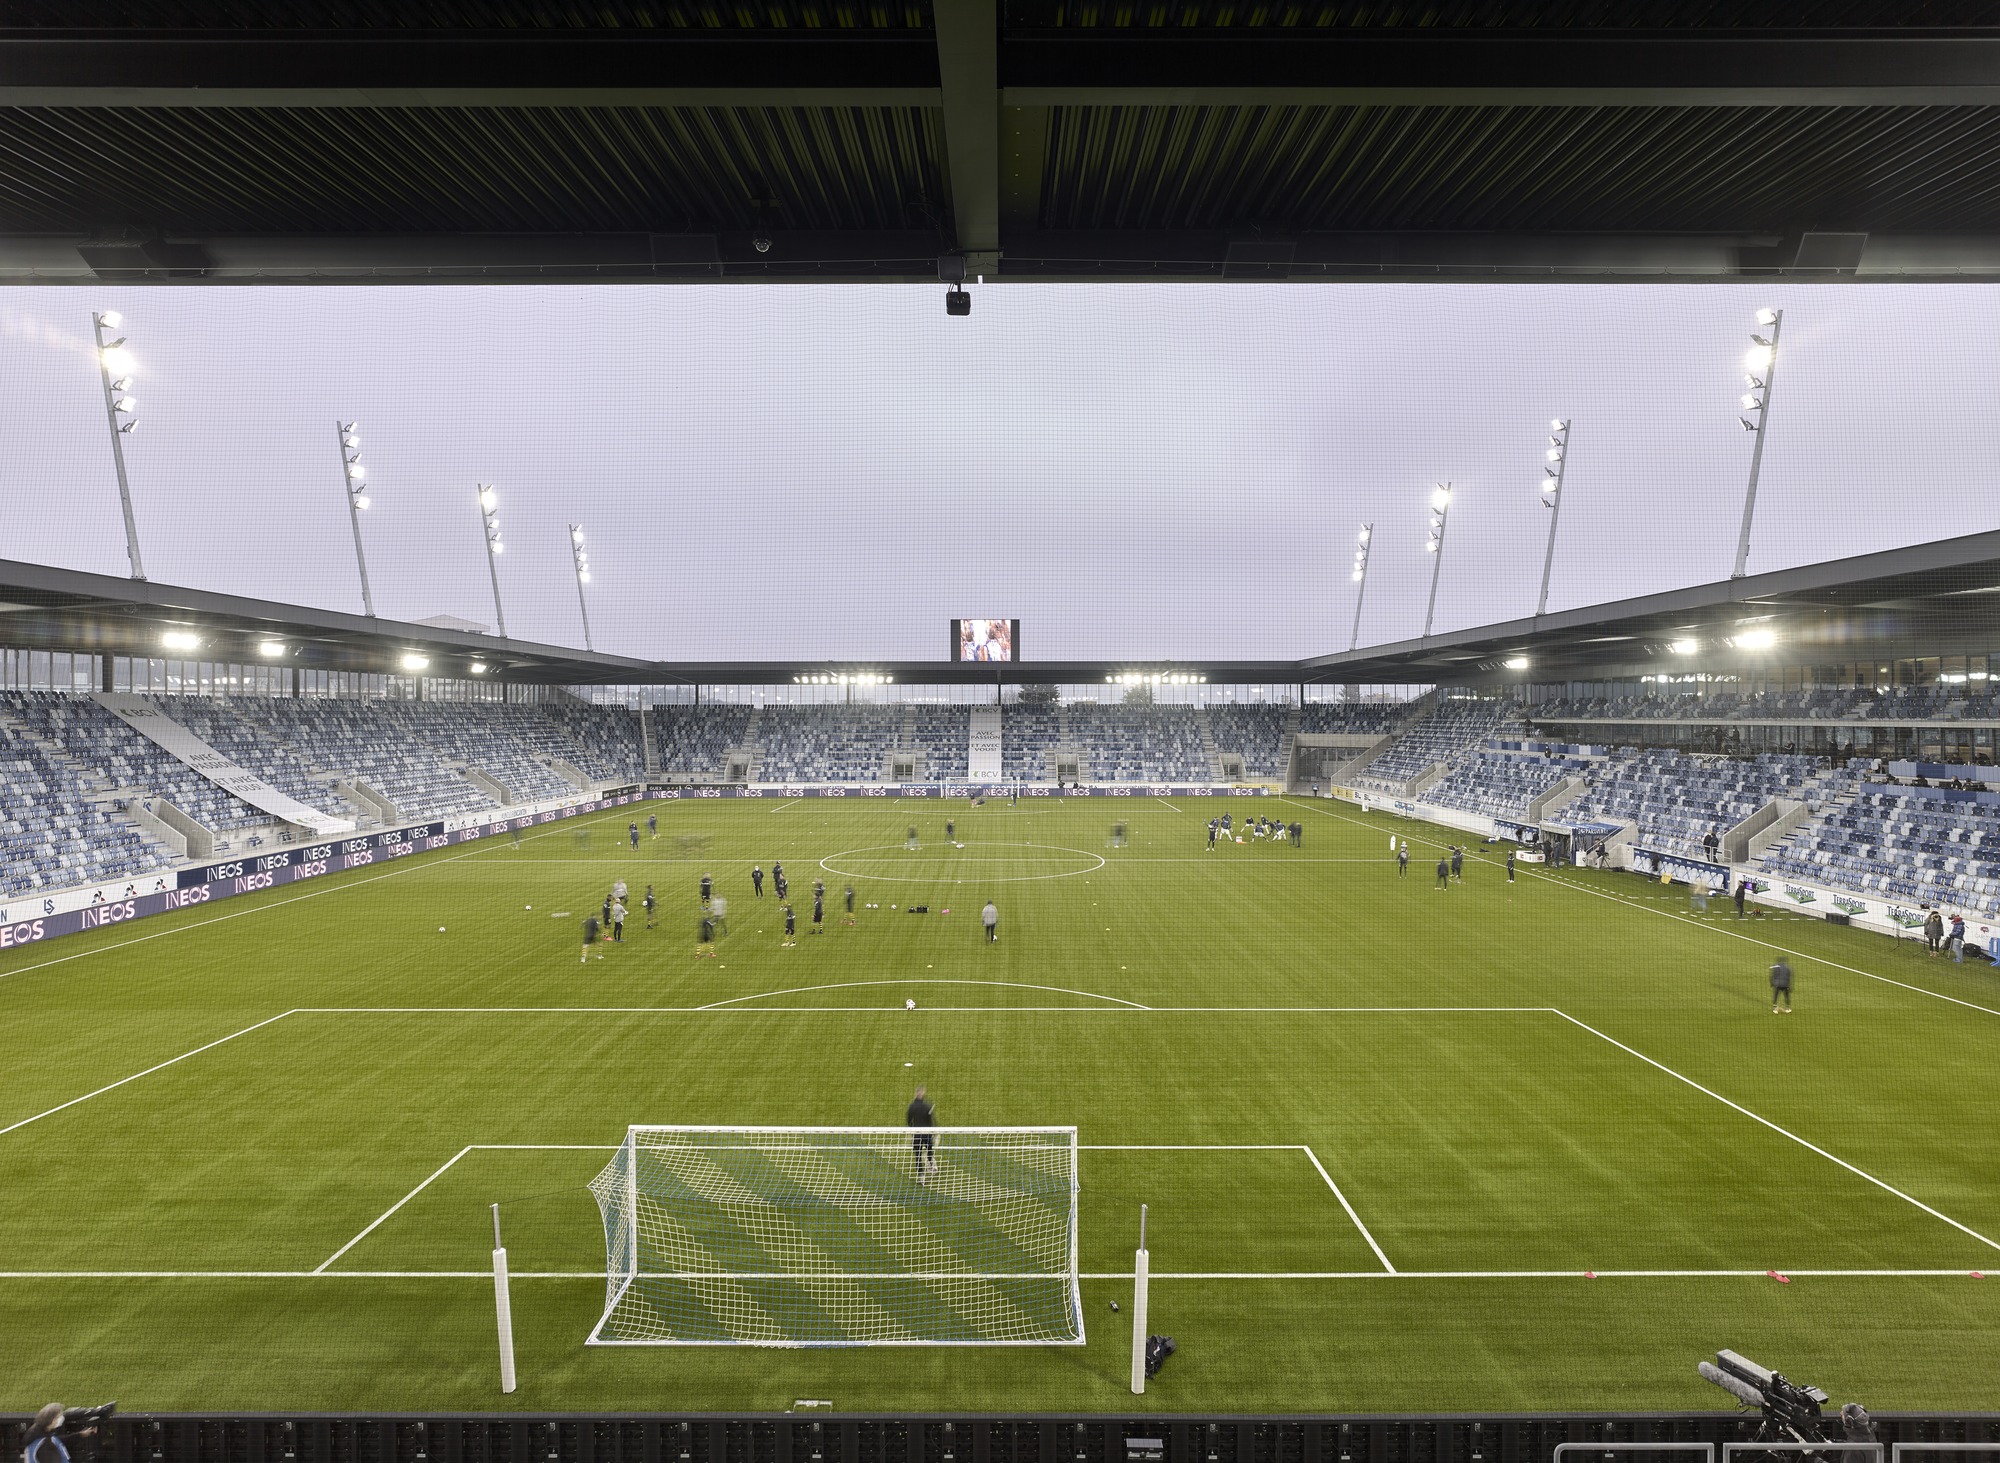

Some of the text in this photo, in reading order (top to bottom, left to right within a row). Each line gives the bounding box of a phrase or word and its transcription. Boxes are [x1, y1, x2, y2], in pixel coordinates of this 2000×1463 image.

[190, 760, 237, 770] PASSION
[230, 776, 258, 784] AVEC
[652, 790, 679, 799] INEOS
[694, 789, 721, 798] INEOS
[736, 789, 762, 797] INEOS
[778, 789, 804, 797] INEOS
[820, 788, 846, 796] INEOS
[860, 788, 886, 796] INEOS
[902, 788, 927, 796] INEOS
[540, 811, 556, 823] INEOS
[562, 806, 576, 818] INEOS
[490, 822, 508, 835] INEOS
[516, 816, 533, 829] INEOS
[378, 832, 402, 846] INEOS
[408, 826, 428, 840] INEOS
[460, 828, 480, 842] INEOS
[342, 838, 368, 854] INEOS
[426, 834, 449, 850] INEOS
[303, 844, 332, 862] INEOS
[388, 842, 413, 858] INEOS
[256, 853, 289, 872] INEOS
[344, 850, 372, 868] INEOS
[206, 862, 243, 882] INEOS
[294, 860, 326, 880] INEOS
[234, 871, 273, 894] INEOS
[165, 884, 210, 910] INEOS
[1833, 894, 1866, 911] TERRASPORT
[82, 900, 136, 929] INEOS
